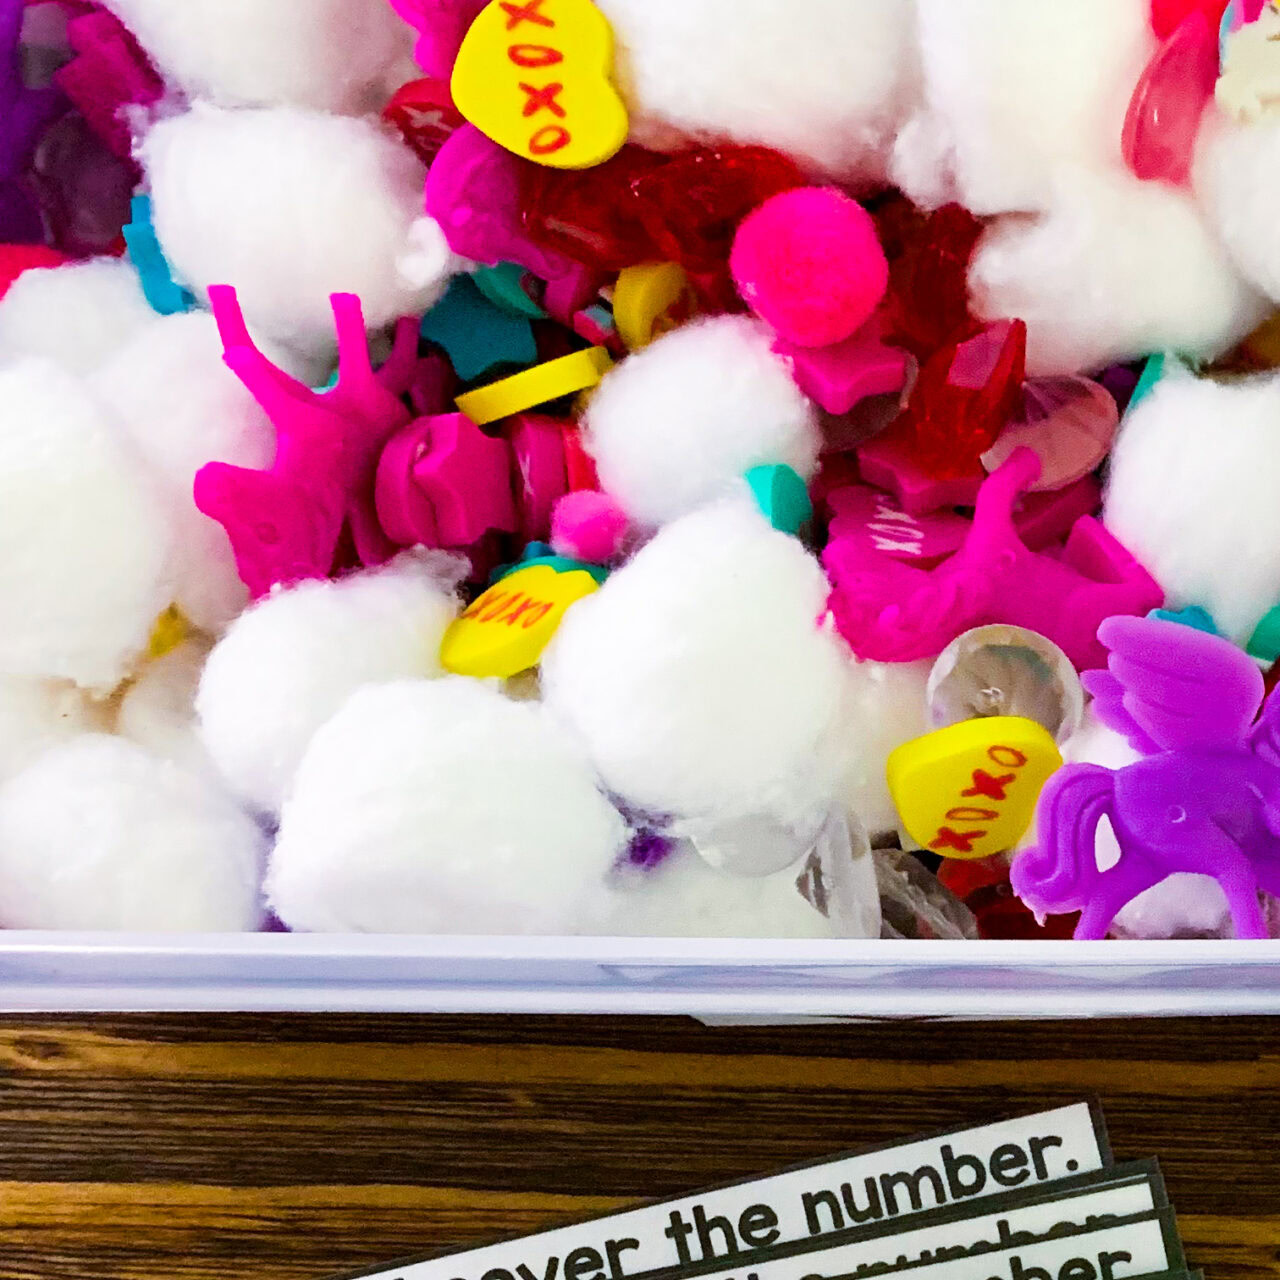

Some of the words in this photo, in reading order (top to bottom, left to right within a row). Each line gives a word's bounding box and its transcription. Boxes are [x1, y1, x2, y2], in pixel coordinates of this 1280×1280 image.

[499, 0, 572, 156] XOXO
[927, 744, 1028, 853] XOXO
[664, 1203, 782, 1266] the
[800, 1132, 1080, 1237] number.
